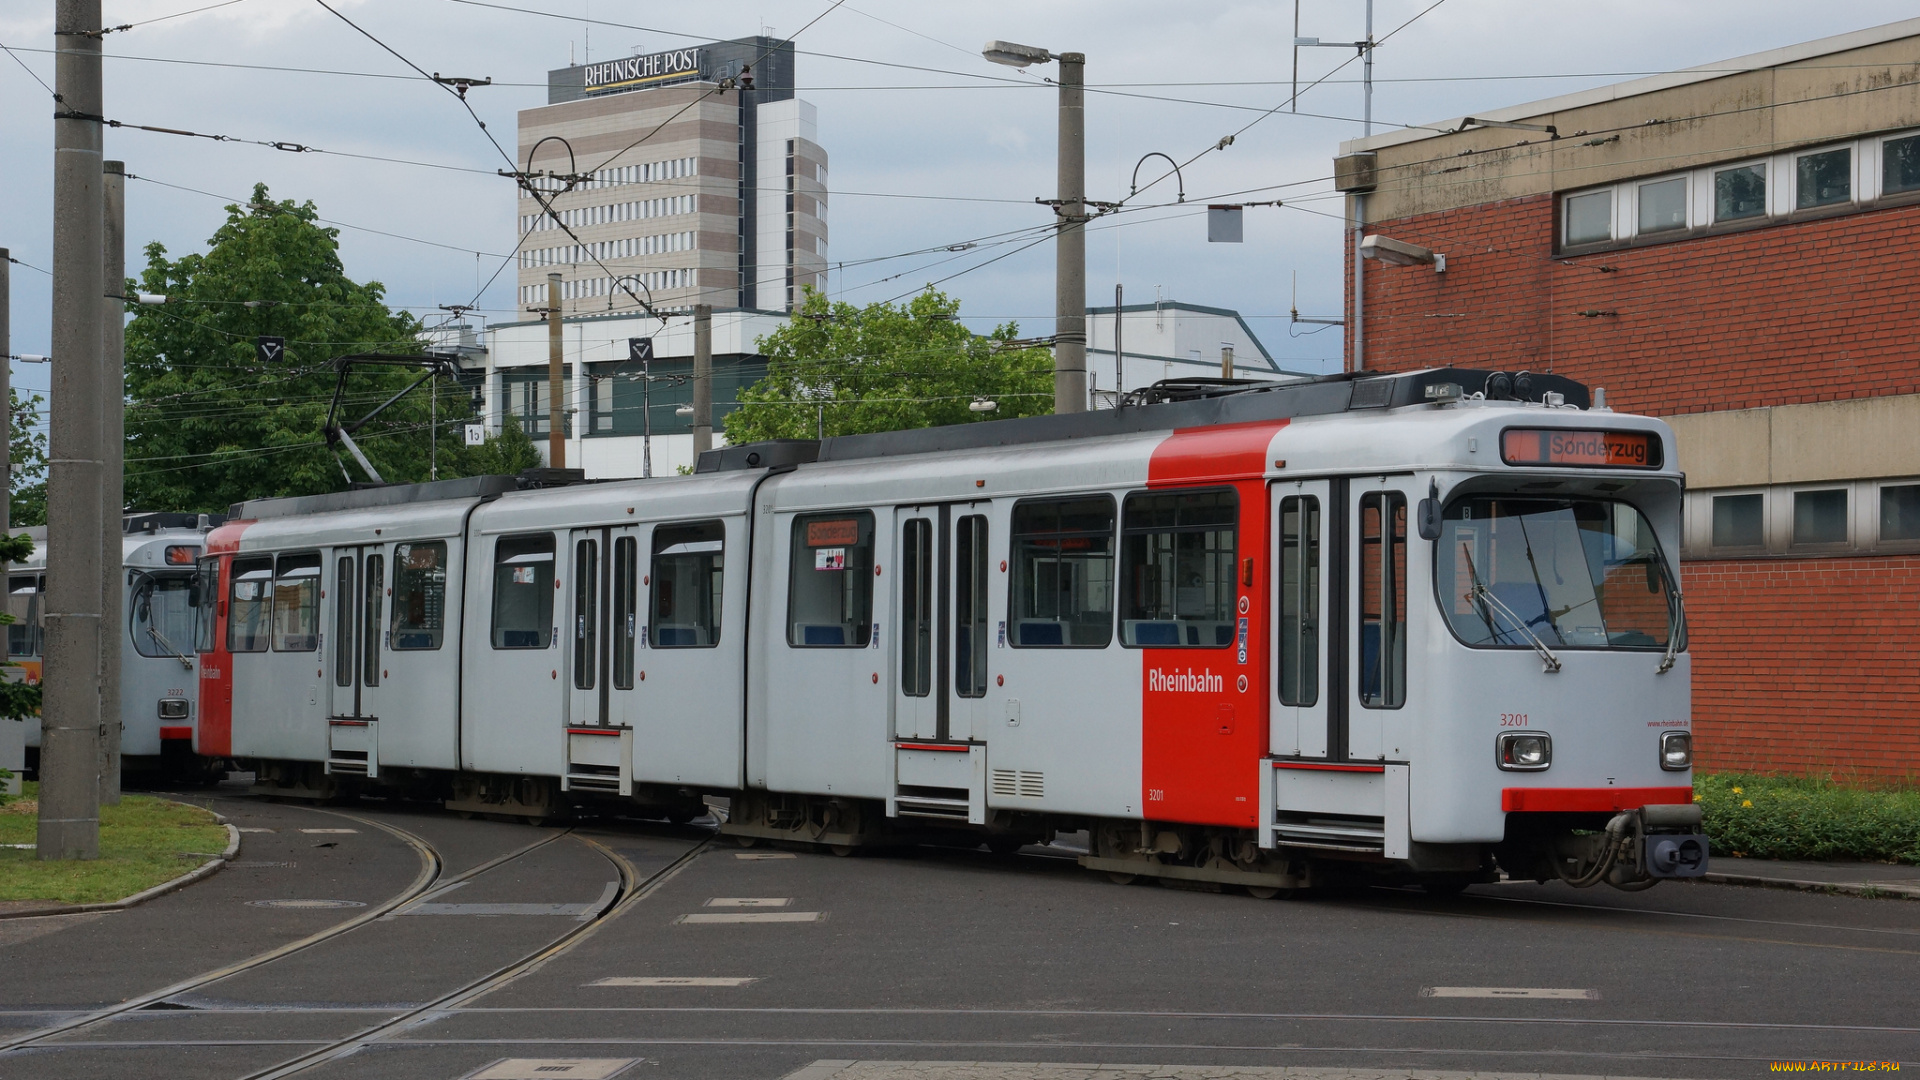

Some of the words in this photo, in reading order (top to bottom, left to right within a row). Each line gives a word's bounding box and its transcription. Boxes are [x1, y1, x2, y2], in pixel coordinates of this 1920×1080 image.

[585, 54, 661, 87] RHEINISCHE
[665, 48, 699, 73] POST
[1552, 435, 1645, 463] Sonderzug
[810, 524, 857, 542] Sonderzug
[1149, 667, 1223, 693] Rheinbahn
[167, 688, 184, 696] 3222
[1500, 713, 1528, 727] 3201
[1646, 719, 1689, 728] www.rheinbahn.de
[1149, 789, 1163, 801] 3201
